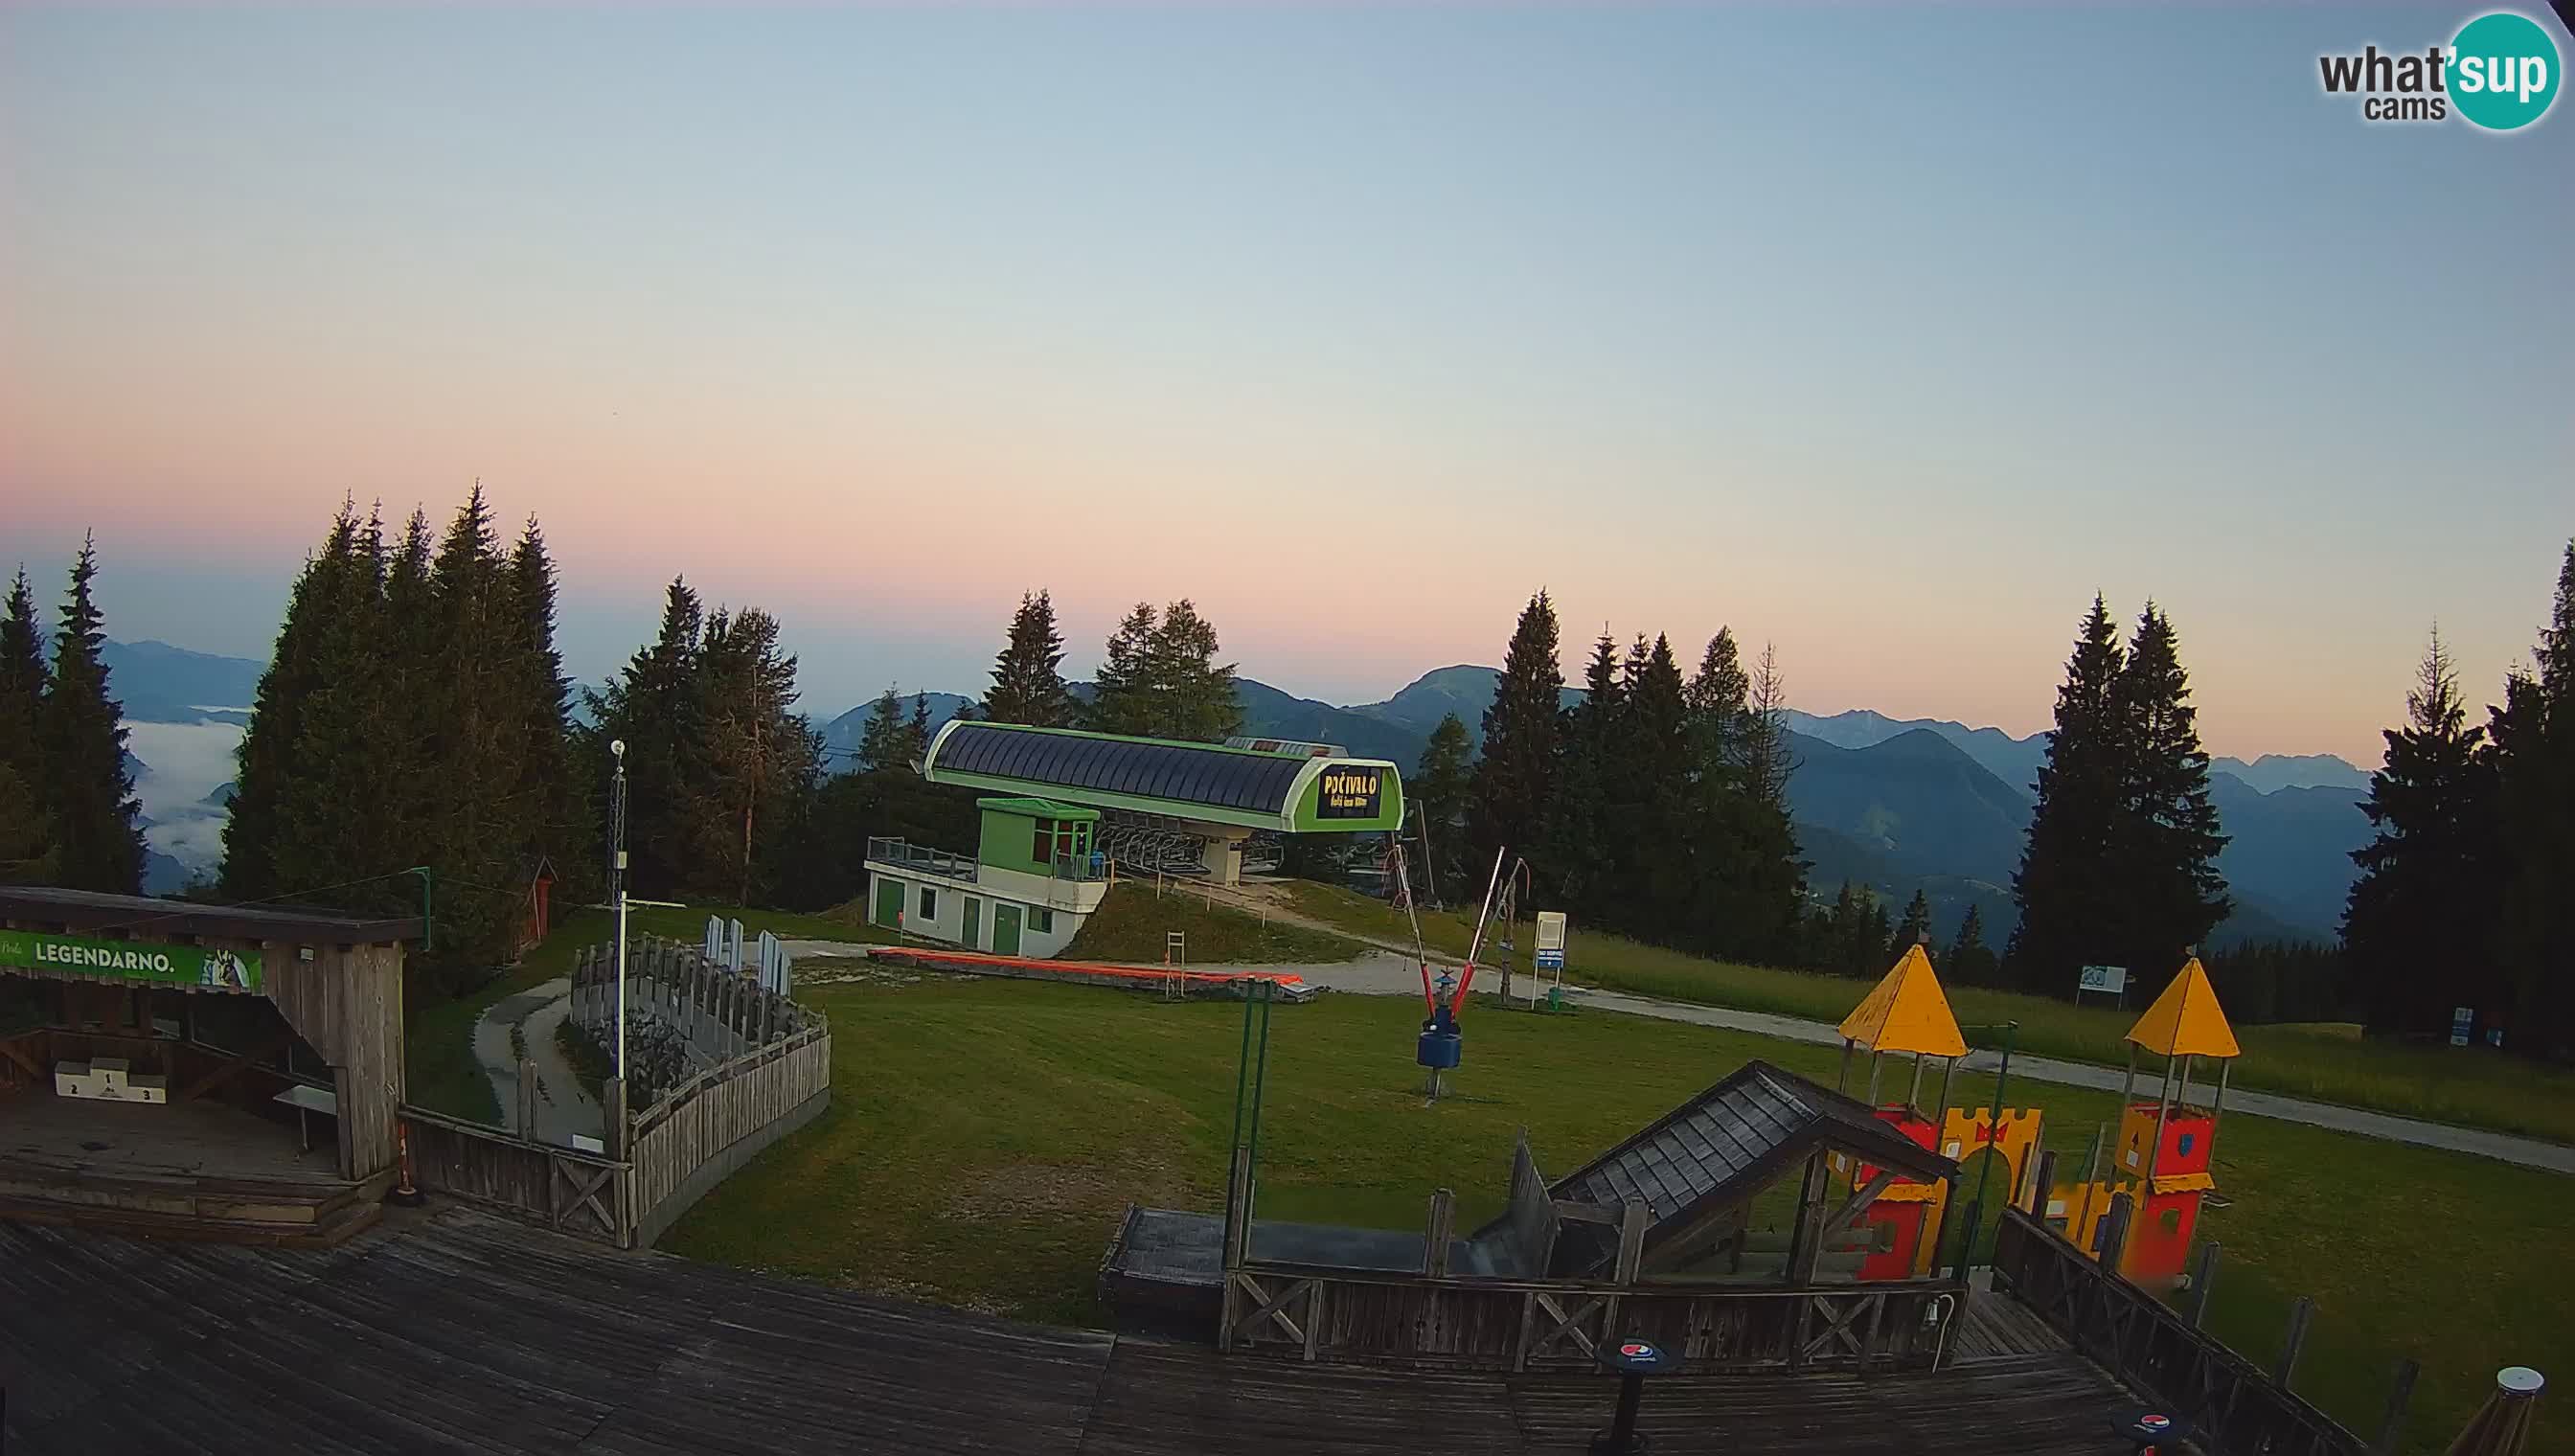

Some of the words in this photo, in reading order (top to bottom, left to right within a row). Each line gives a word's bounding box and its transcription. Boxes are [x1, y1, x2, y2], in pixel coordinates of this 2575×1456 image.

[1325, 772, 1377, 794] POČIVALO
[35, 942, 175, 973] LEGENDARNO.
[71, 1084, 78, 1094] 2
[143, 1090, 150, 1100] 3
